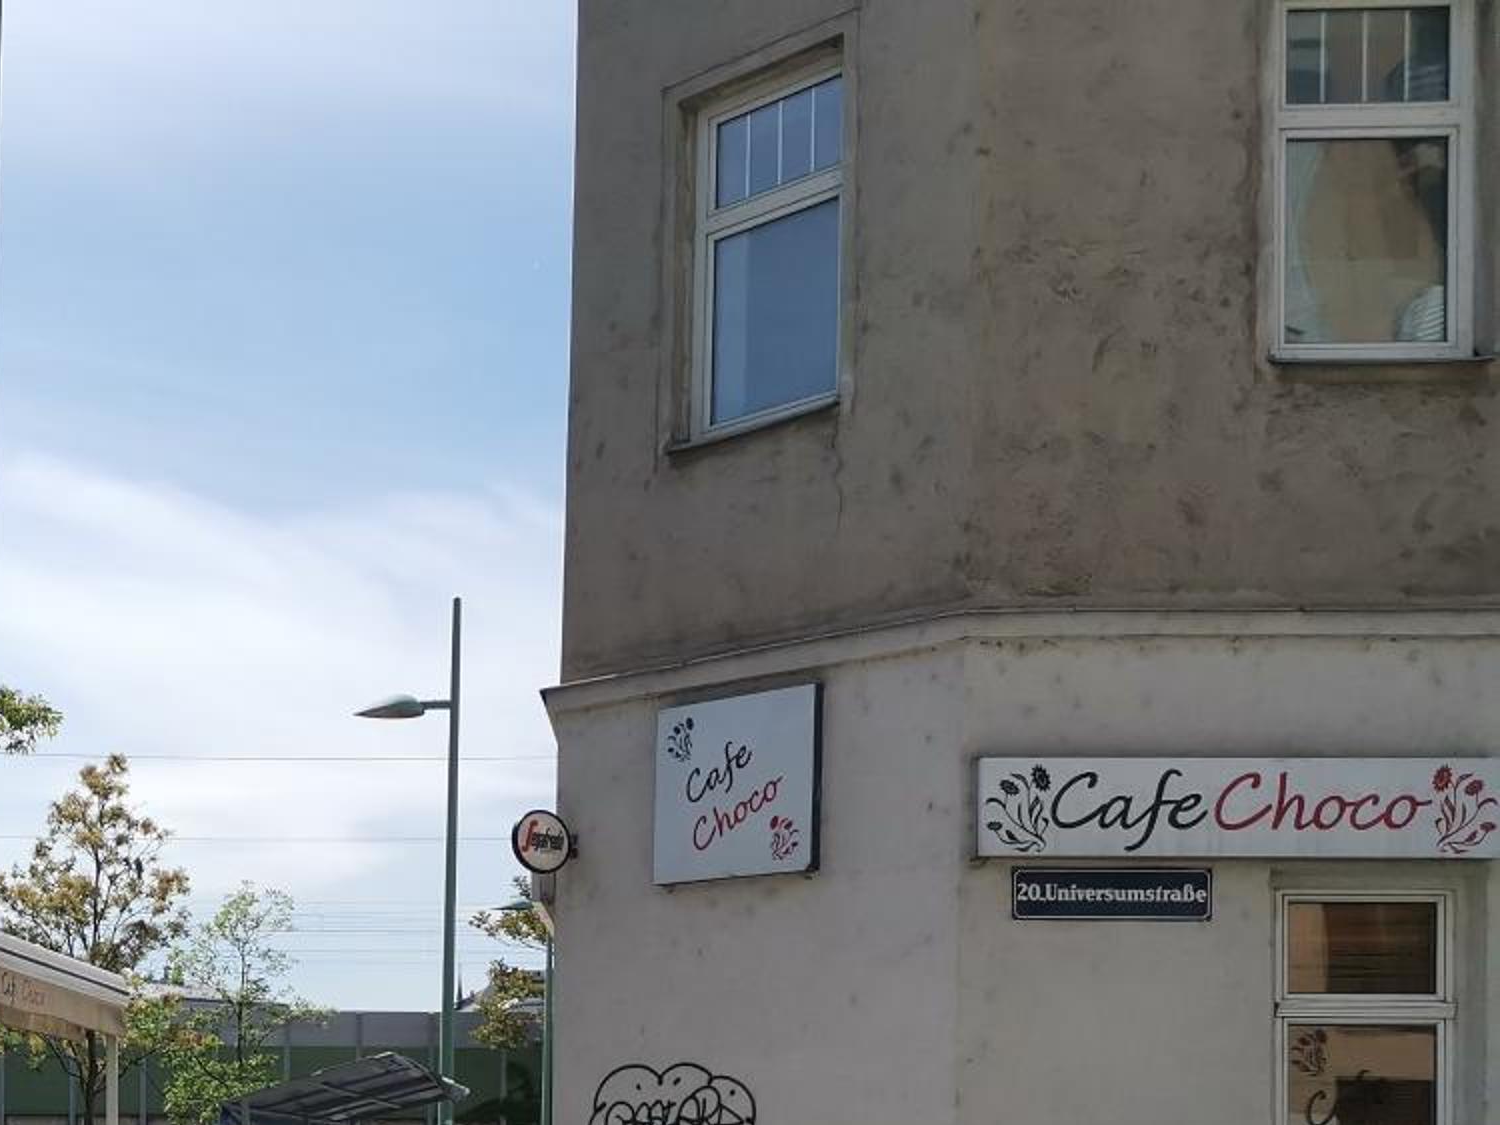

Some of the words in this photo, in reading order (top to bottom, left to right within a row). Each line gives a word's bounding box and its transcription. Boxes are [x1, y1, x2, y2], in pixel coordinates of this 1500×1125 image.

[686, 741, 752, 803] Cafe
[693, 776, 783, 851] Choco
[1051, 769, 1208, 851] Cafe
[1214, 772, 1431, 831] Choco
